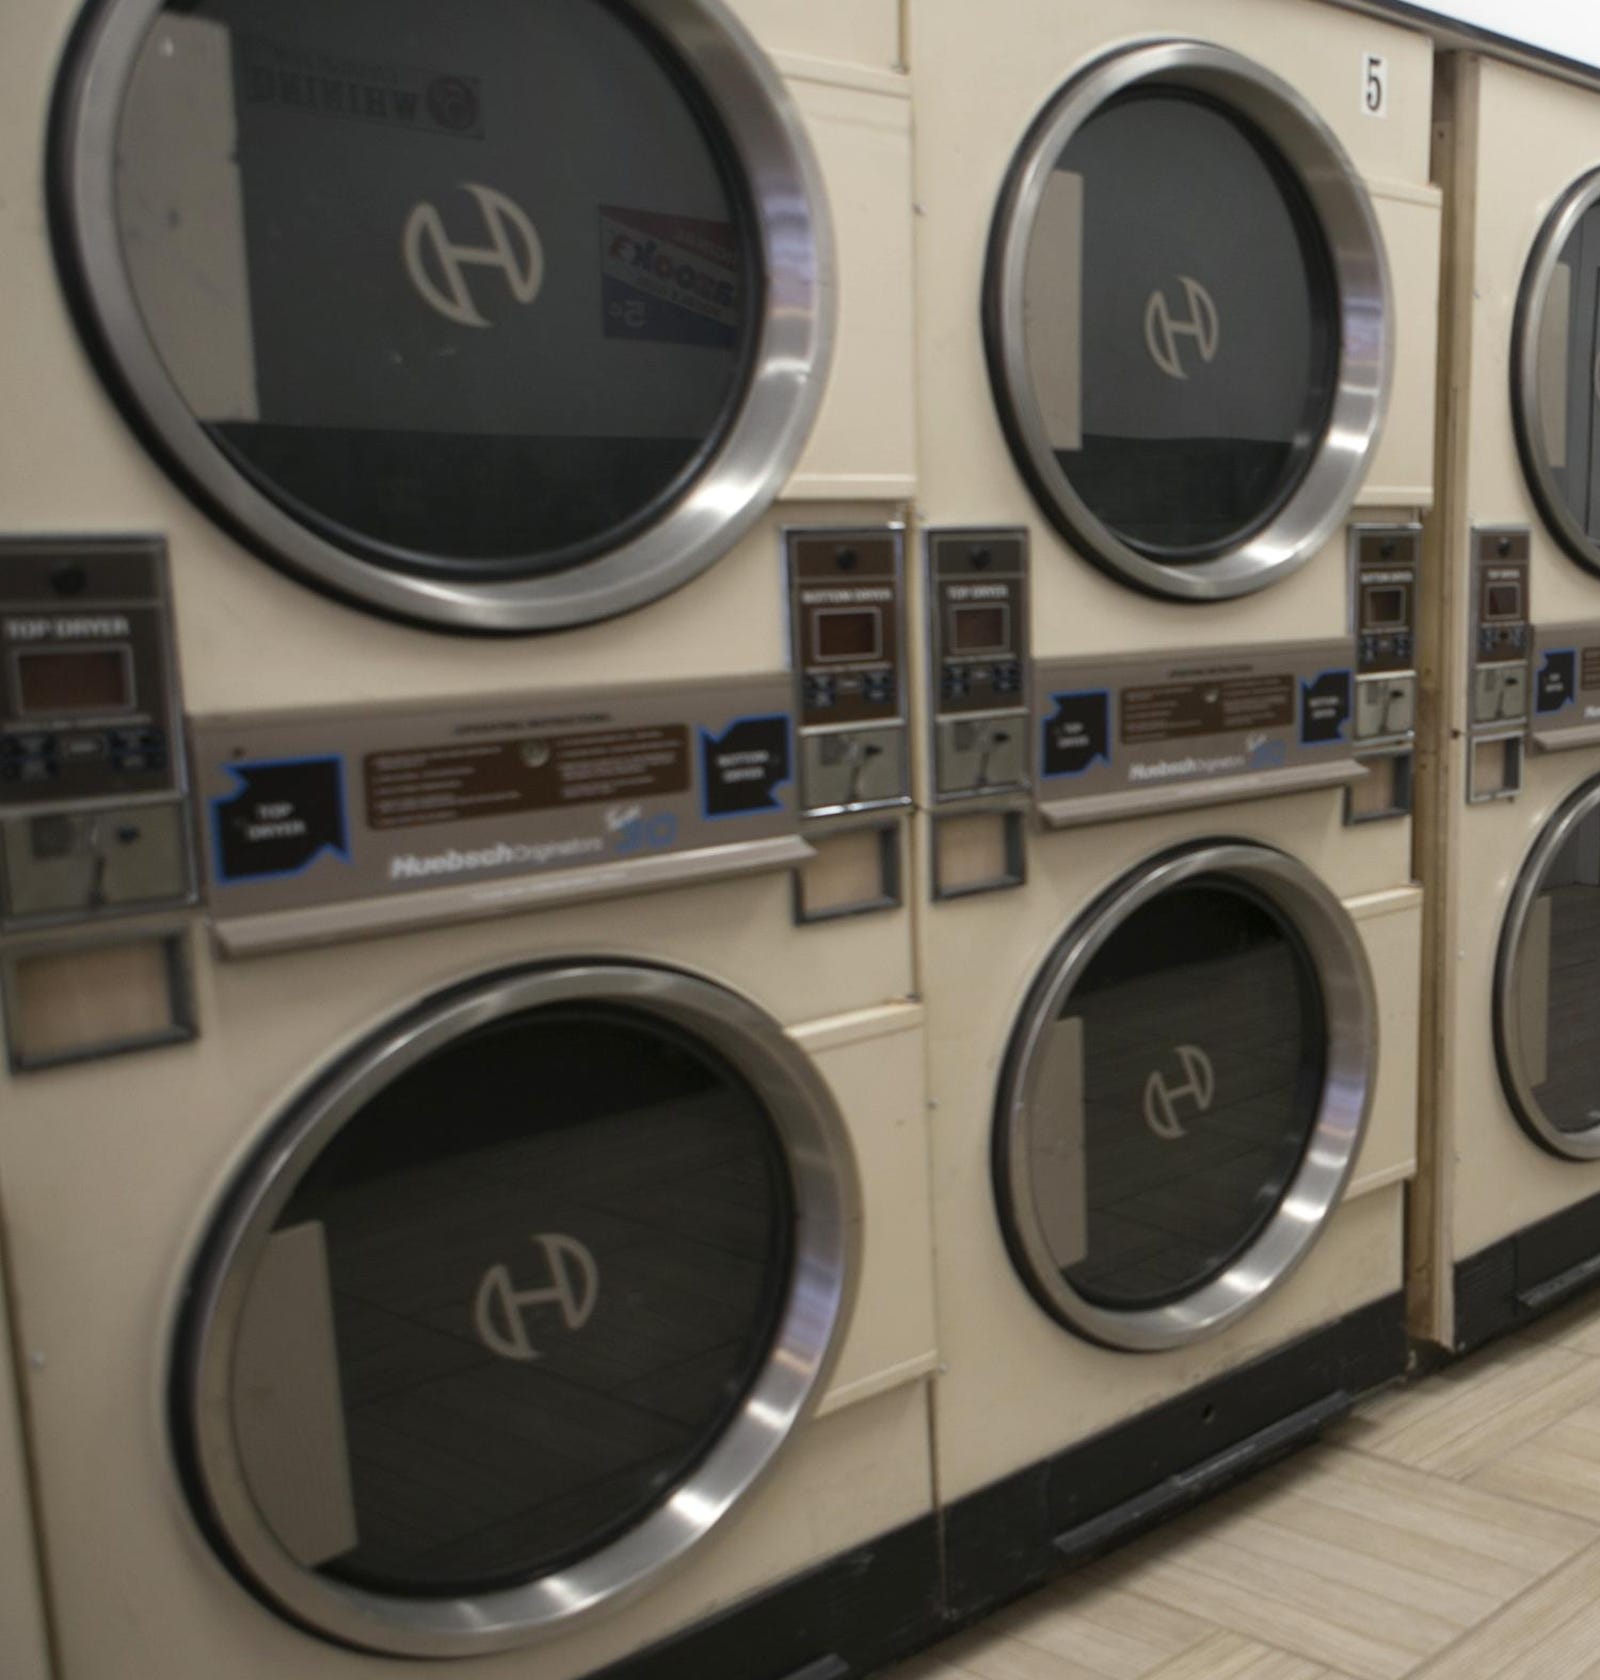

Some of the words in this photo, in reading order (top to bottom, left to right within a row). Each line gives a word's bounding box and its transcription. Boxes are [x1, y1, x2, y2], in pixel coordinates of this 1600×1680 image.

[1366, 57, 1382, 112] 5
[7, 618, 51, 640] TOP
[54, 615, 132, 639] DRYER
[389, 841, 514, 881] Huebsch
